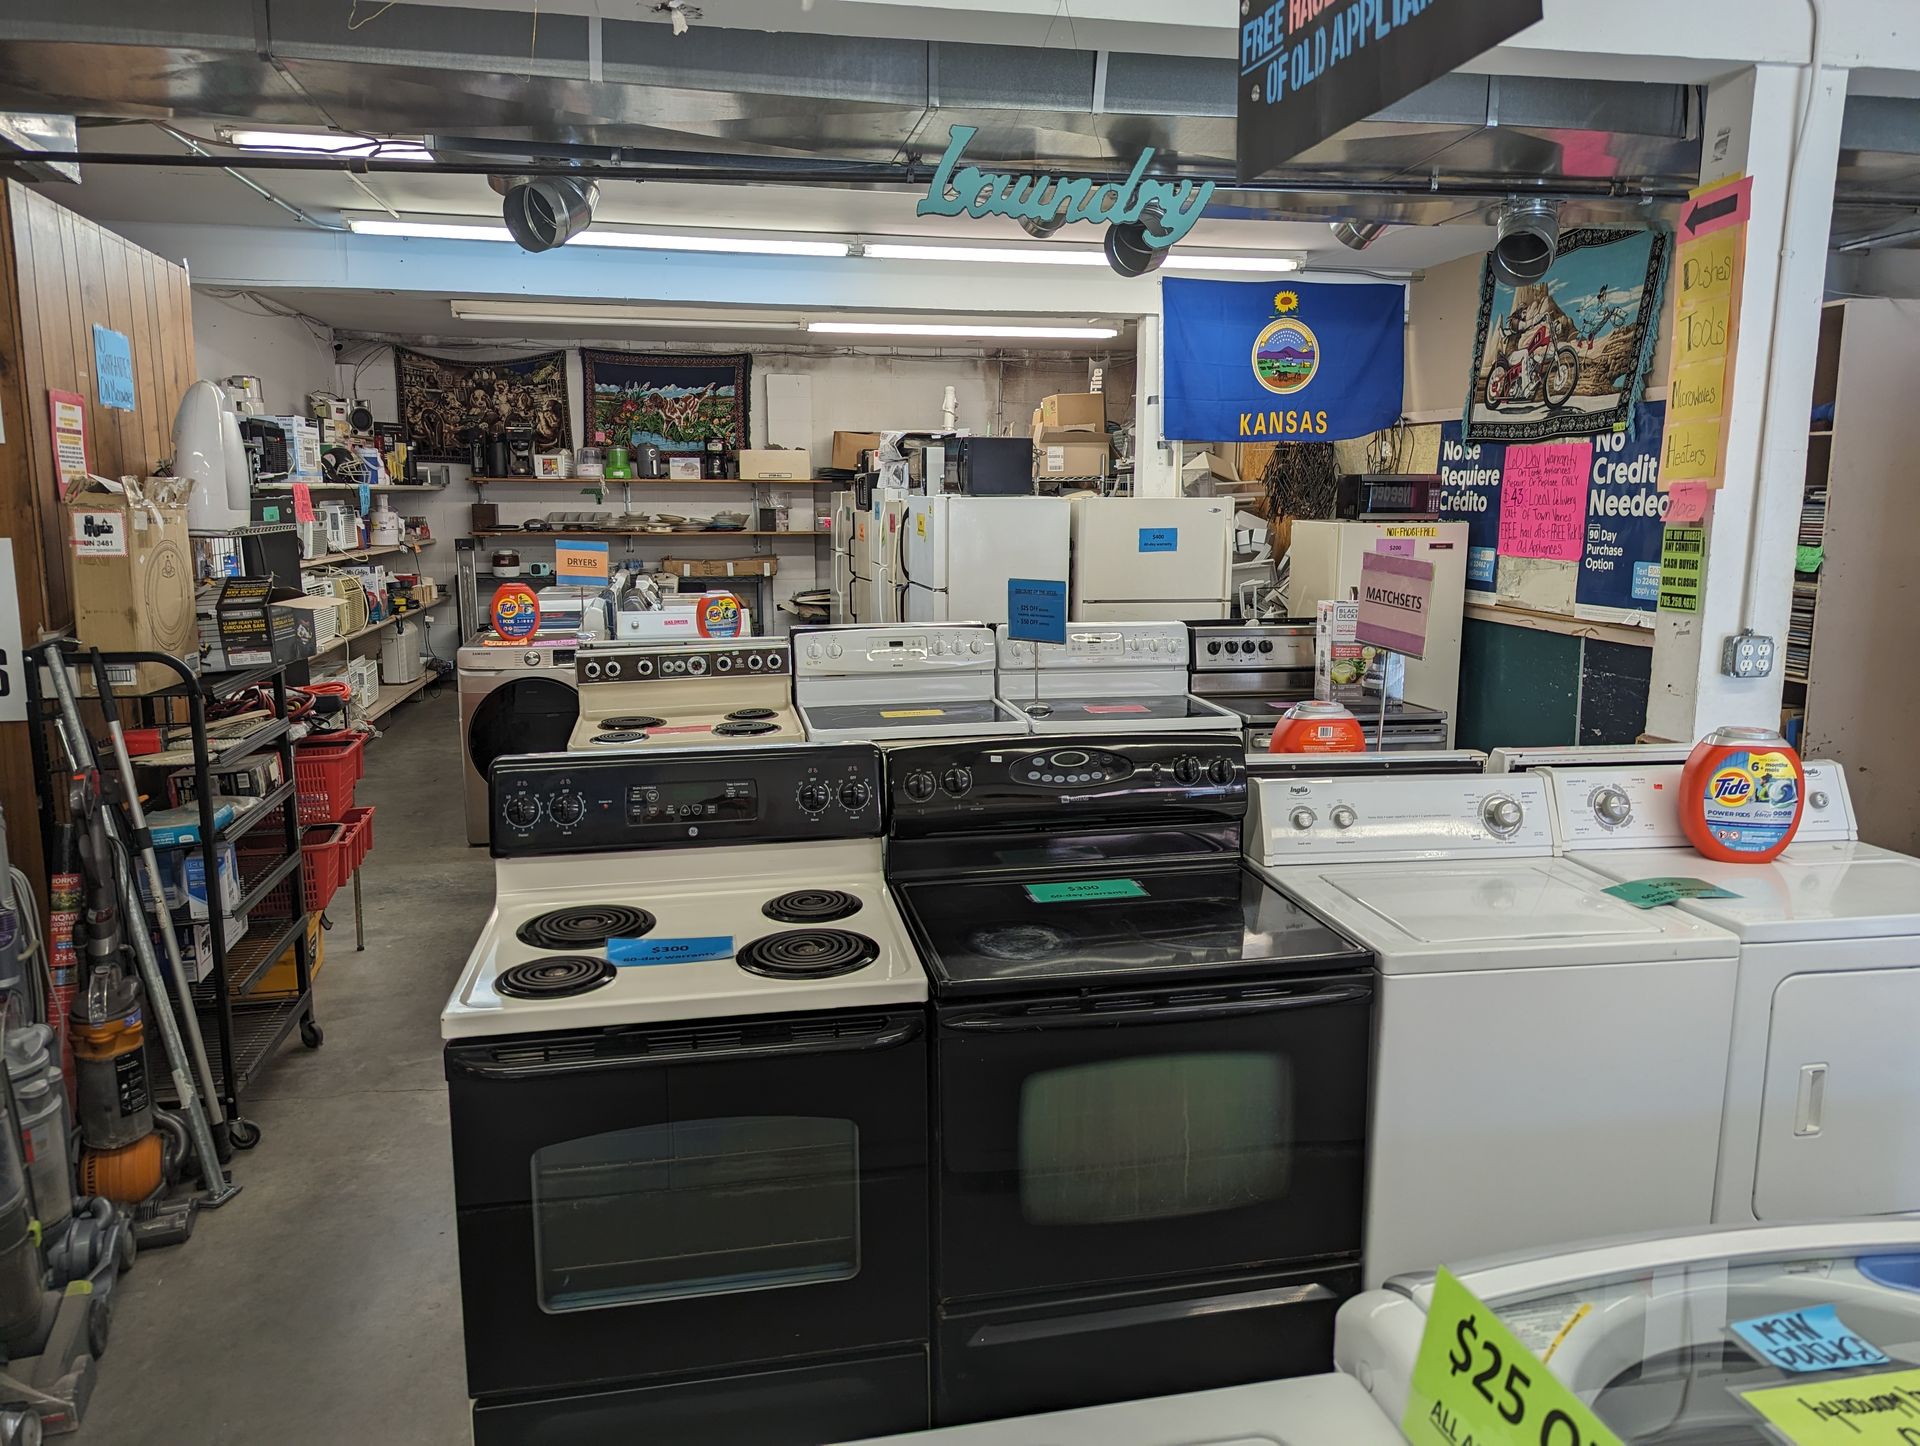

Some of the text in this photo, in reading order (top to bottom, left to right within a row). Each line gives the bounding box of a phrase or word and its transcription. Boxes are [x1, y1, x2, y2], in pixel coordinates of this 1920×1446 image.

[1241, 0, 1285, 67] FREE
[1266, 52, 1289, 104] OF
[1291, 25, 1327, 91] OLD
[916, 124, 1216, 249] Laundry
[1683, 250, 1731, 293] Dishes
[1680, 305, 1726, 352] Tools
[1671, 379, 1716, 410] Microwaves
[1239, 410, 1328, 436] KANSAS
[1443, 440, 1462, 461] No
[1595, 431, 1626, 452] No
[1665, 434, 1707, 469] Heaters
[1525, 447, 1541, 468] Day
[1544, 443, 1578, 472] Warranty
[1441, 465, 1500, 490] Requiere
[1593, 453, 1658, 485] Credit
[1561, 475, 1579, 486] ONLY
[1439, 490, 1488, 512] Crédito
[1501, 522, 1517, 539] FREE
[1588, 529, 1617, 544] 90 Day
[1586, 544, 1623, 556] Purchase
[1665, 542, 1700, 553] ANY CONDITION
[567, 557, 598, 567] DRYERS
[1585, 557, 1614, 571] Option
[1663, 558, 1698, 570] CASH BUYERS
[1661, 576, 1697, 588] QUICK CLOSING
[500, 603, 516, 614] Tide
[1366, 586, 1422, 610] MATCHSETS
[1290, 786, 1308, 794] Inglis
[1715, 777, 1751, 799] Tide
[1707, 809, 1734, 817] POWER
[652, 945, 689, 954] $300
[665, 951, 716, 960] warranty
[1449, 1314, 1531, 1426] $25
[1431, 1399, 1458, 1442] ALL
